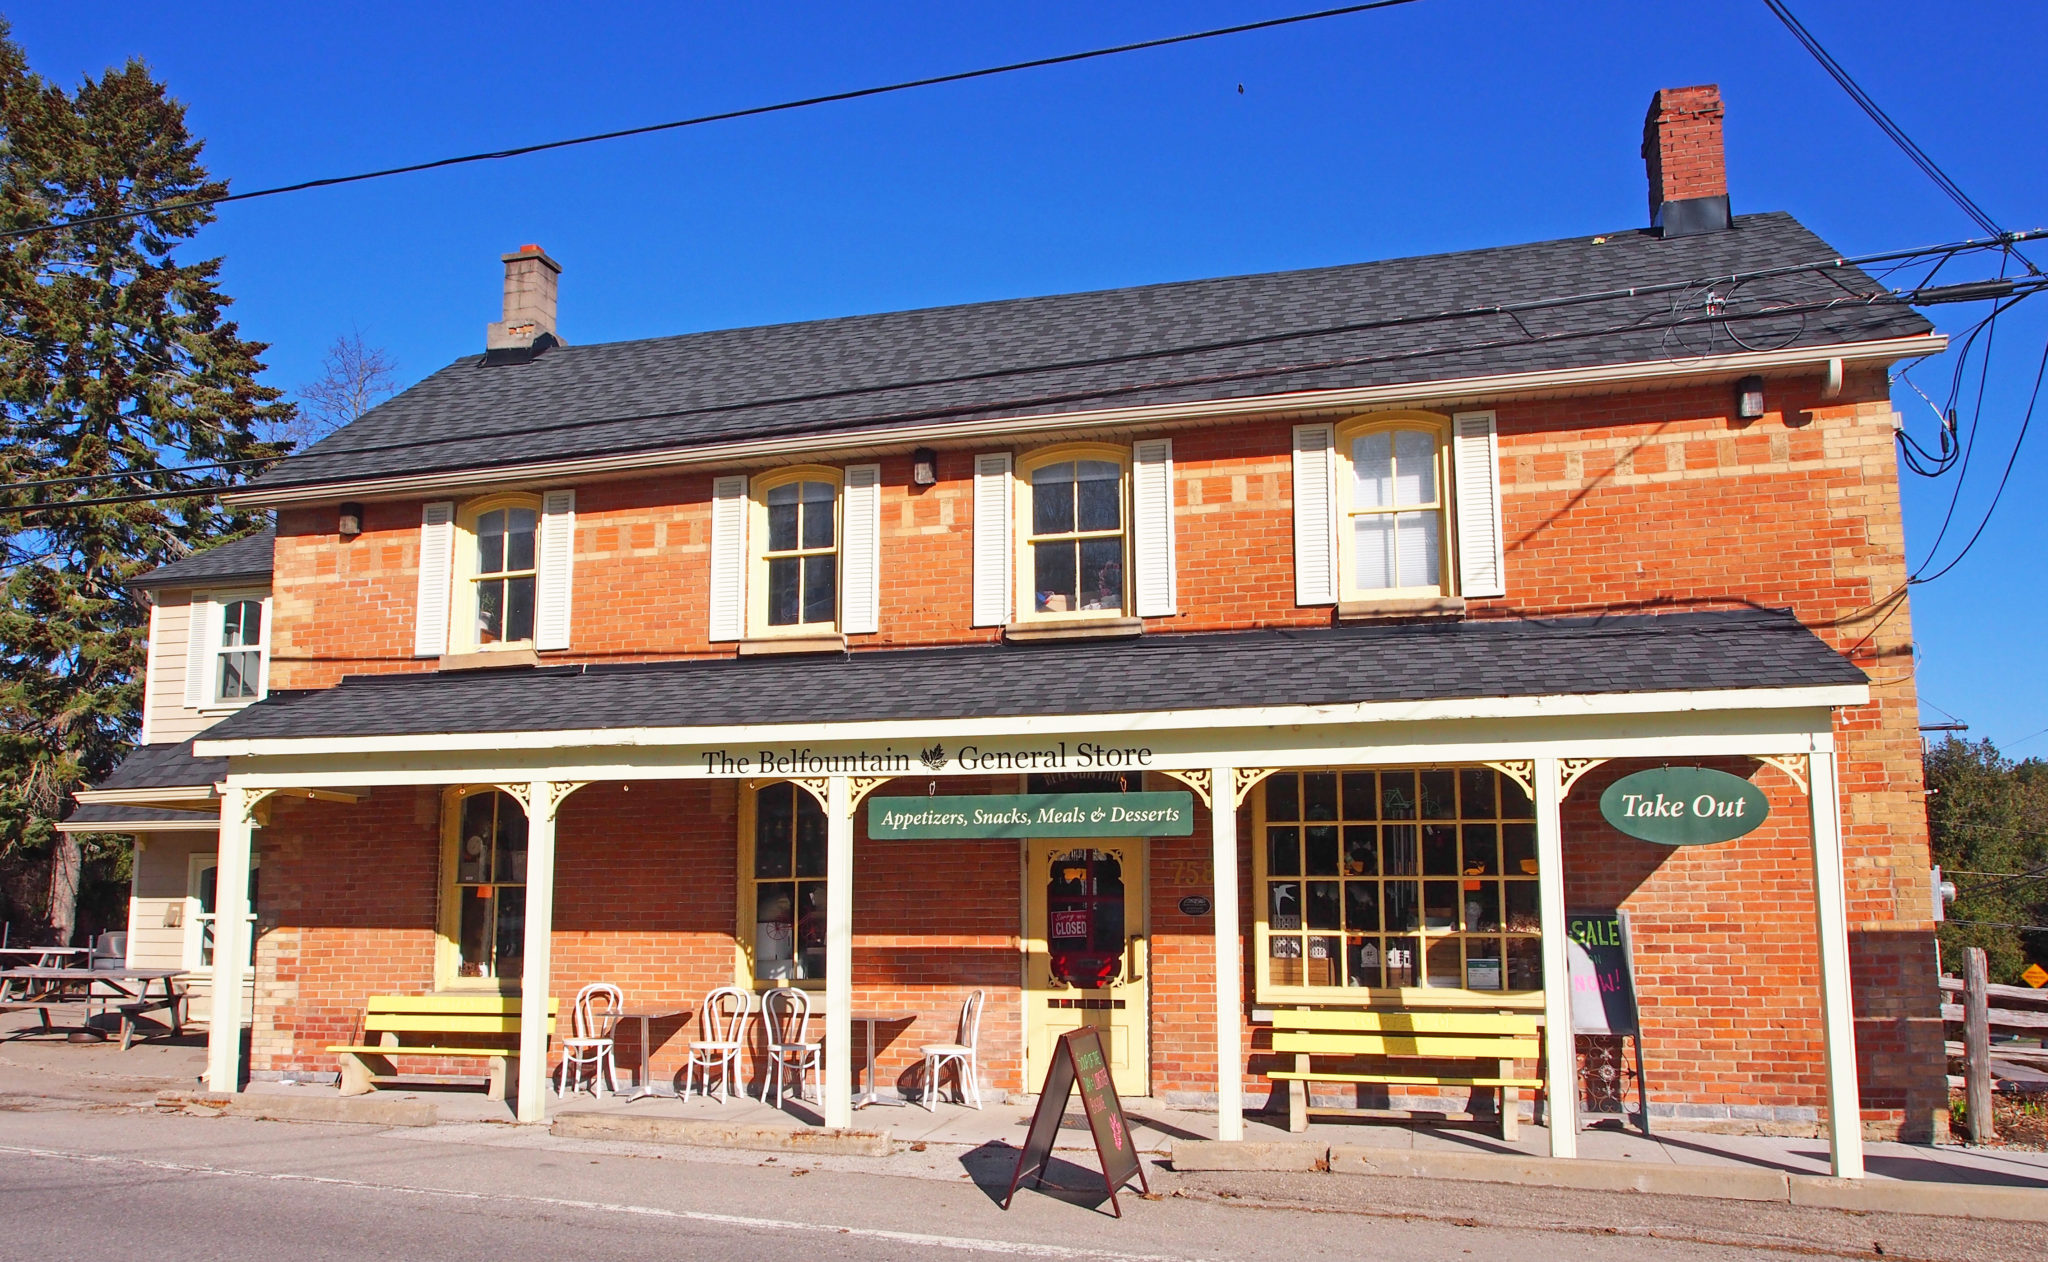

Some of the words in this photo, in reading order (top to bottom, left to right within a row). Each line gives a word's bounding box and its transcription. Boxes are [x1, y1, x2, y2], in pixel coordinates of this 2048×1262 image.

[702, 750, 750, 774] The
[758, 747, 911, 774] Belfountain
[958, 742, 1067, 770] General
[1077, 742, 1153, 768] Store
[1621, 793, 1684, 818] Take
[1692, 794, 1746, 818] Out
[881, 809, 968, 830] Appetizers,
[973, 808, 1032, 826] Snacks,
[1037, 807, 1086, 823] Meals
[1090, 810, 1105, 823] &
[1111, 806, 1179, 823] Desserts
[1056, 921, 1087, 936] CLOSED
[1568, 920, 1620, 946] SALE
[1574, 969, 1621, 992] NOW!
